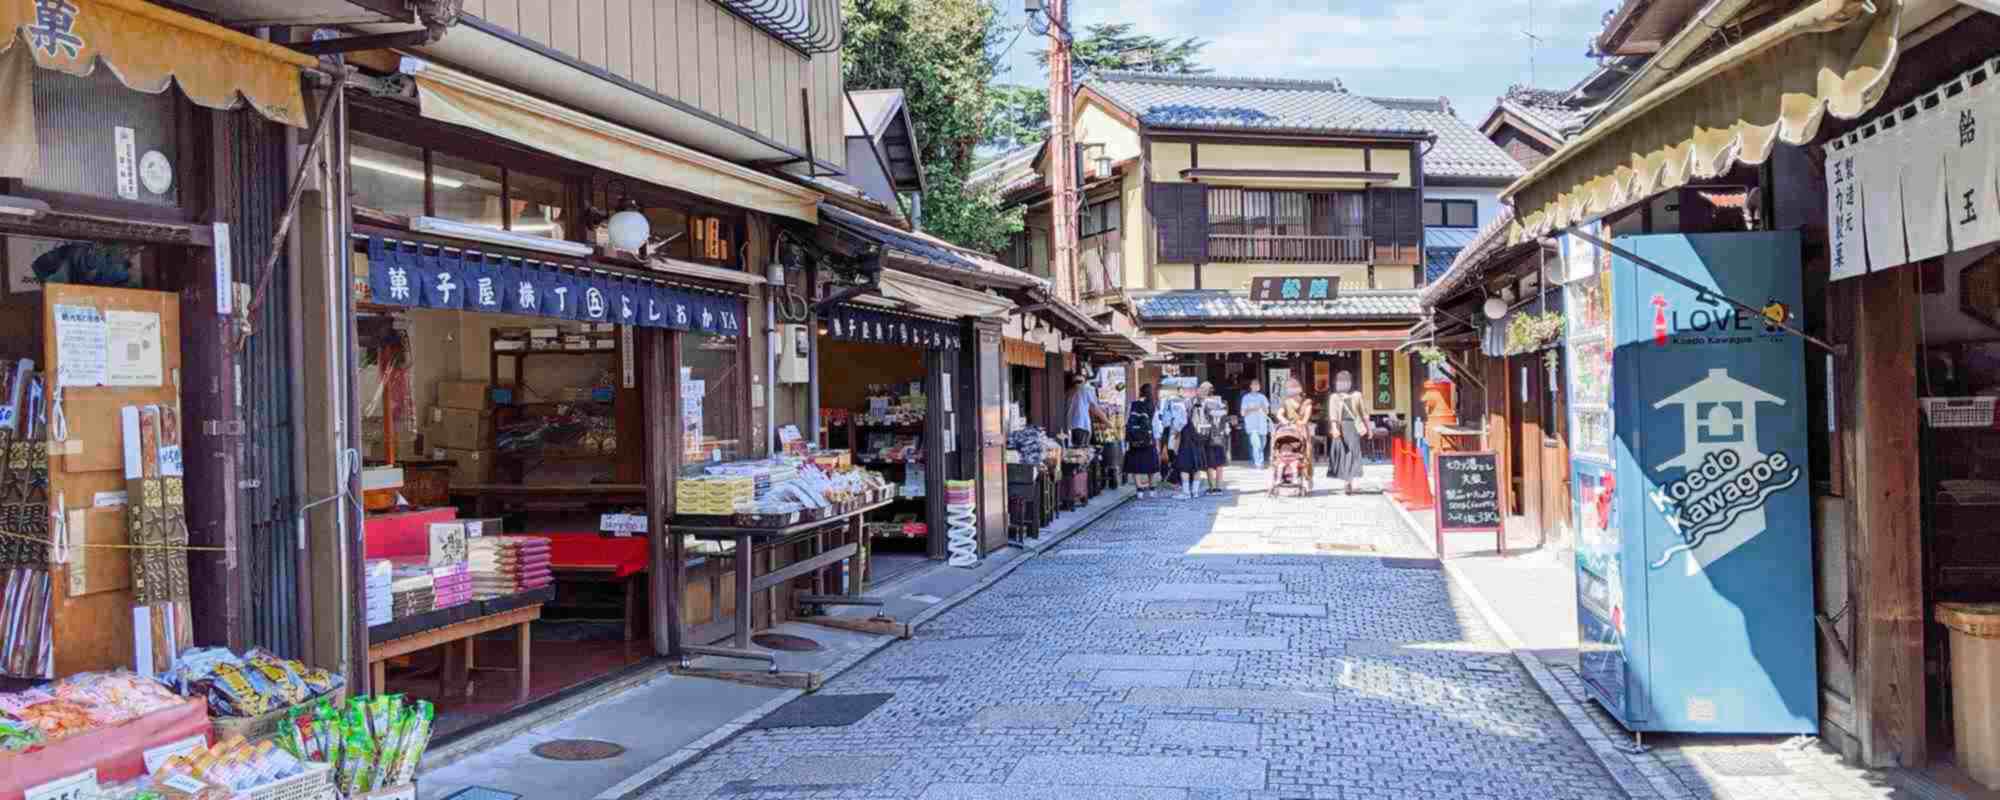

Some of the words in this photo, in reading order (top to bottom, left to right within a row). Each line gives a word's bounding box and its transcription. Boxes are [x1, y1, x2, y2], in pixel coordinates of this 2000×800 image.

[1671, 309, 1753, 333] LOVE
[1648, 448, 1740, 512] Koedo
[1664, 452, 1790, 535] Kawagoe
